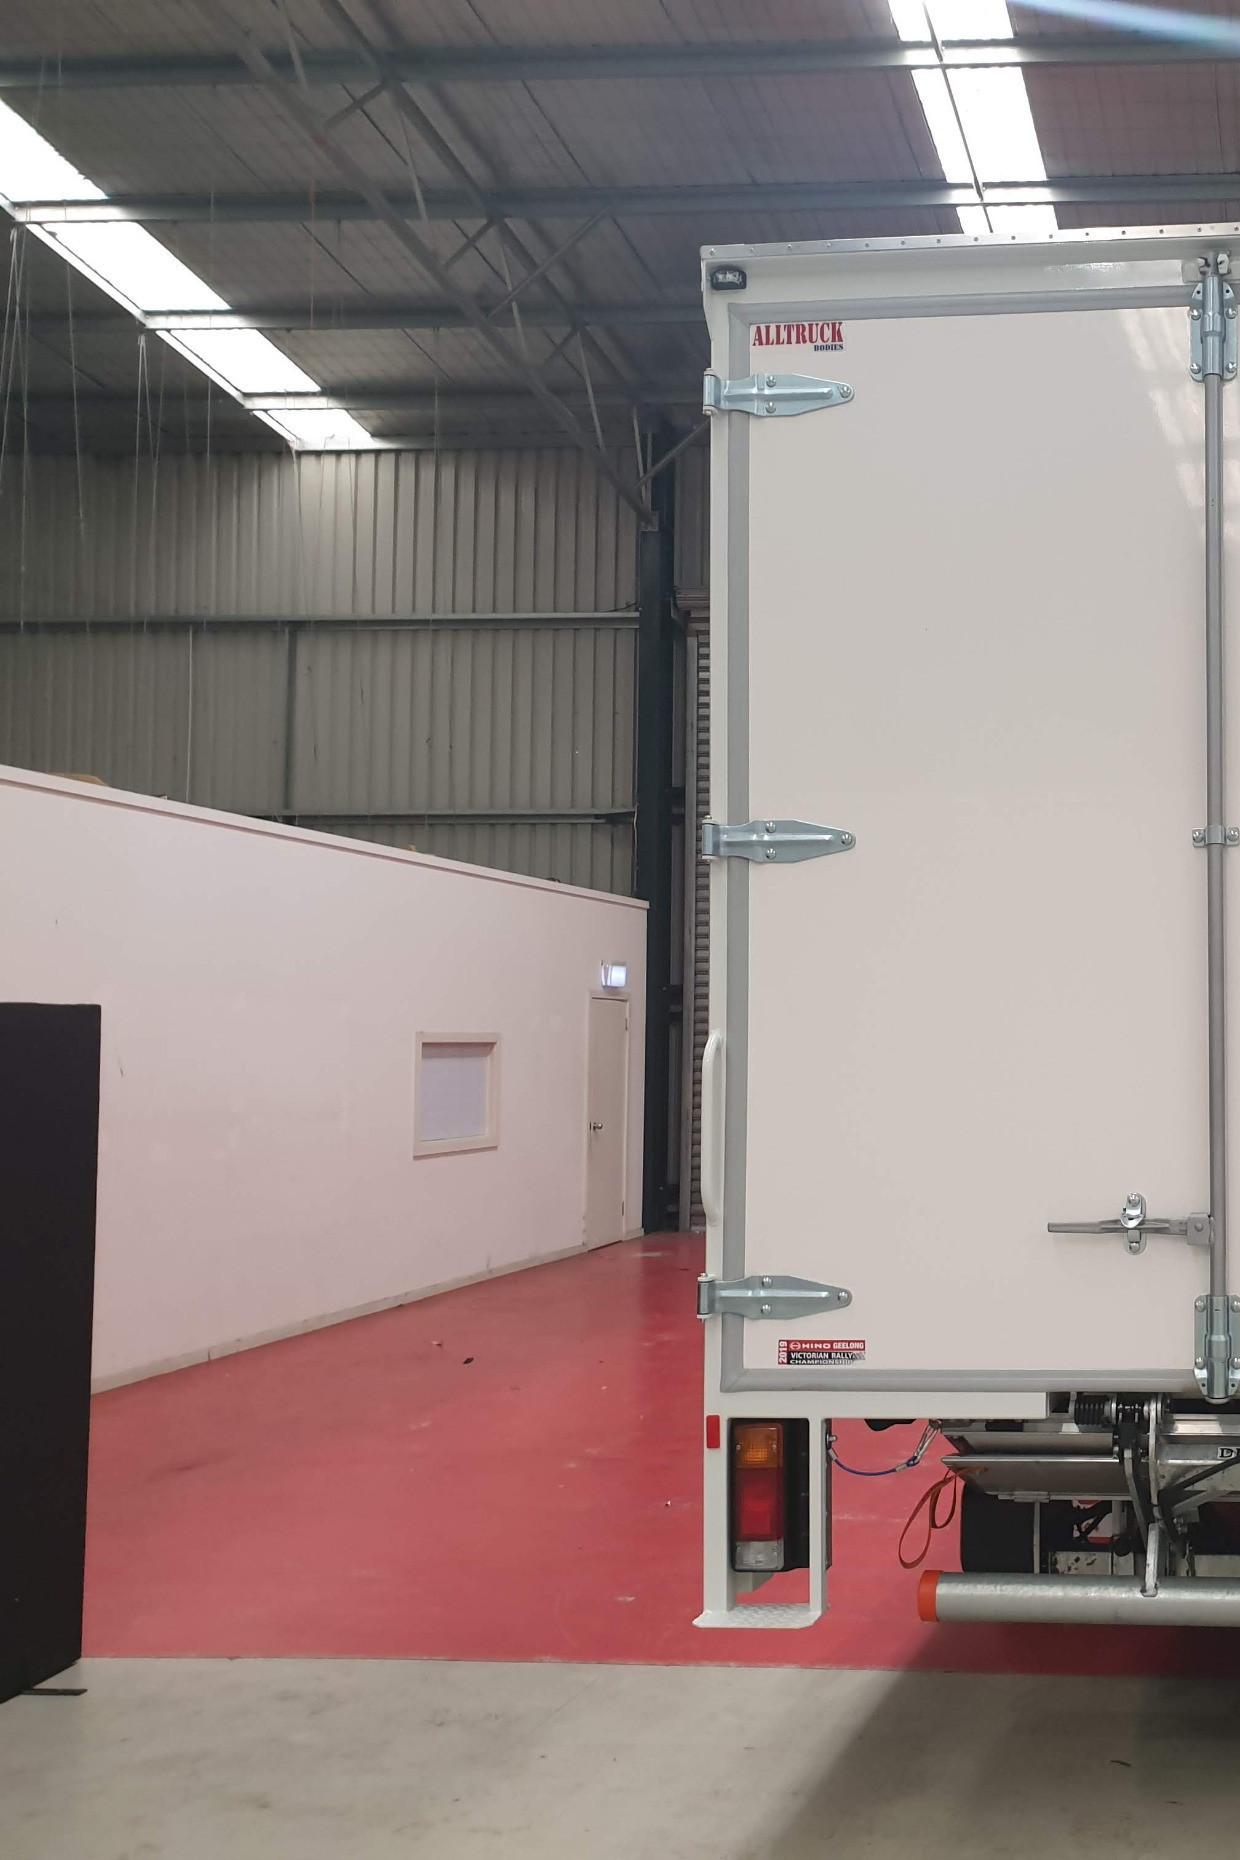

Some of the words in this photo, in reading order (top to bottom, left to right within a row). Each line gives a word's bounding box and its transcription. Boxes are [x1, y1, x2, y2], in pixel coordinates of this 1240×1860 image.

[752, 321, 844, 346] ALLTRUCK
[813, 343, 844, 352] BODIES
[779, 1341, 788, 1363] 2019
